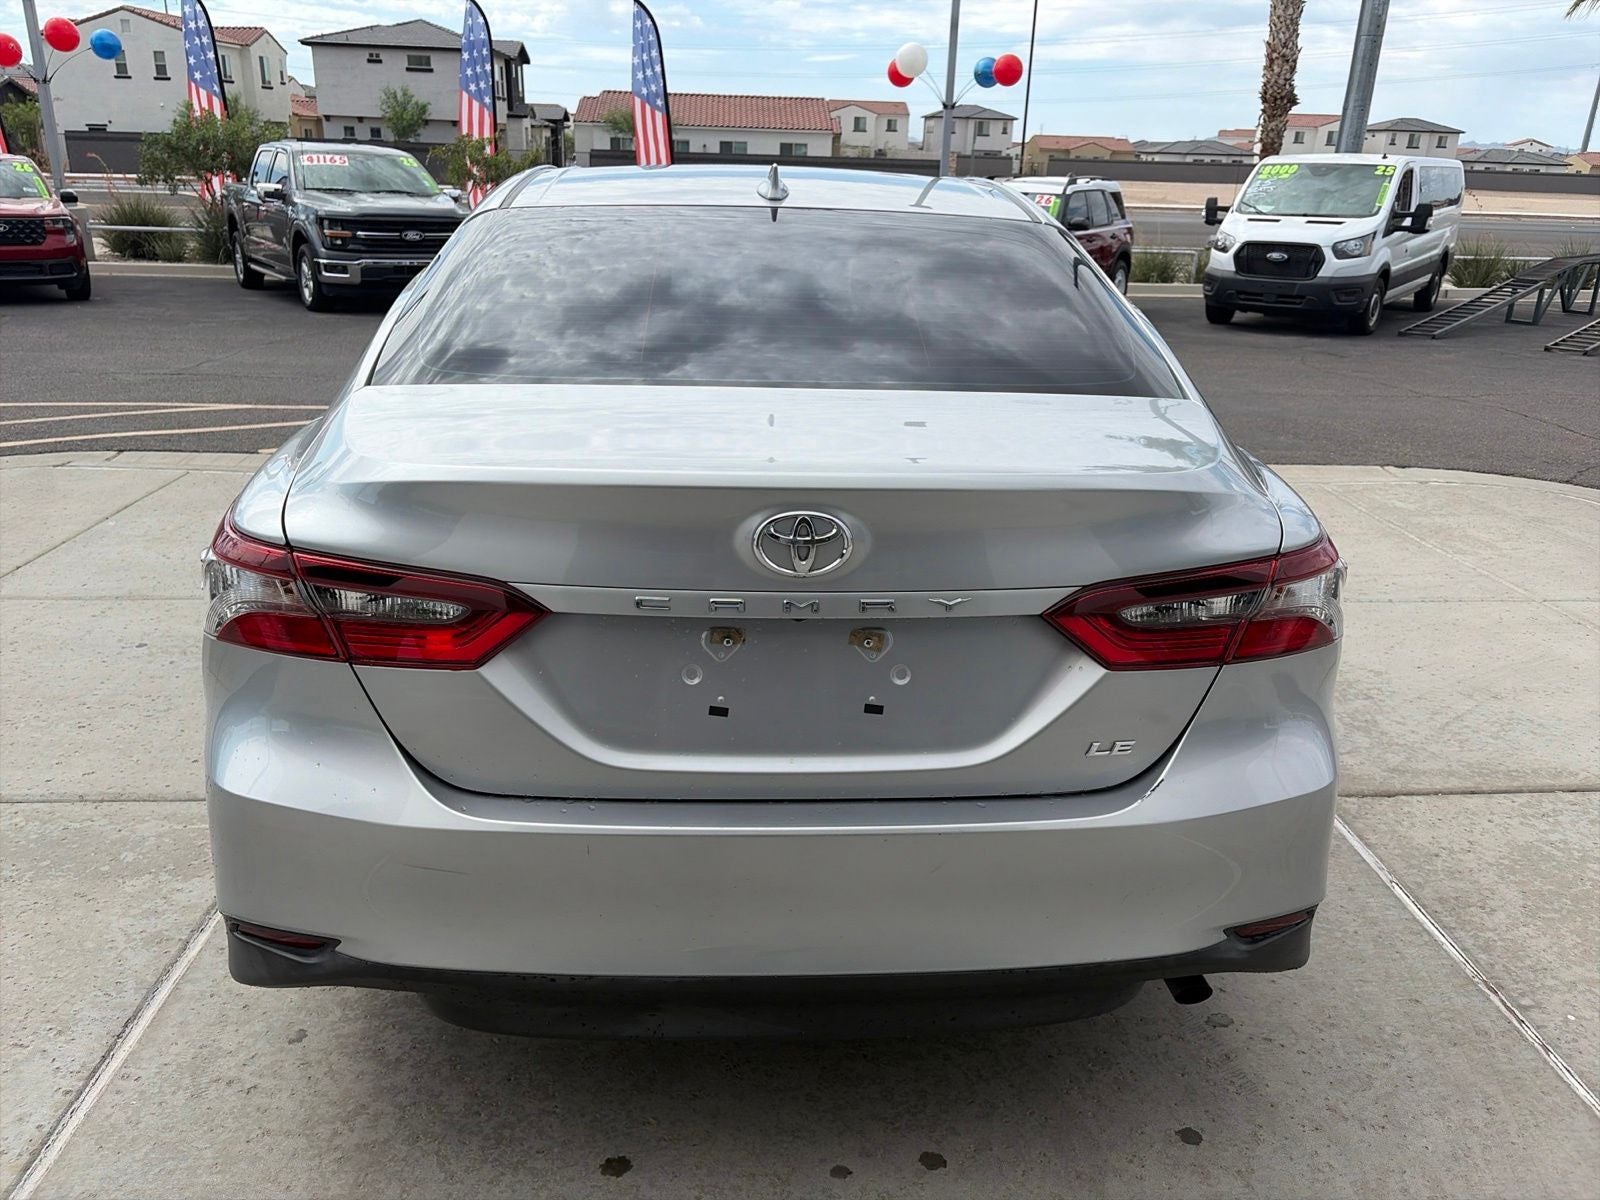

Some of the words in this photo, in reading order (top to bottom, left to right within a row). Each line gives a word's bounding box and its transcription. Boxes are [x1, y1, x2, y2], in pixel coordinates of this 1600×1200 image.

[12, 161, 34, 172] 26
[1374, 165, 1396, 176] 25
[1035, 195, 1052, 205] 26
[634, 595, 973, 613] CAMRY
[1085, 740, 1136, 756] LE
